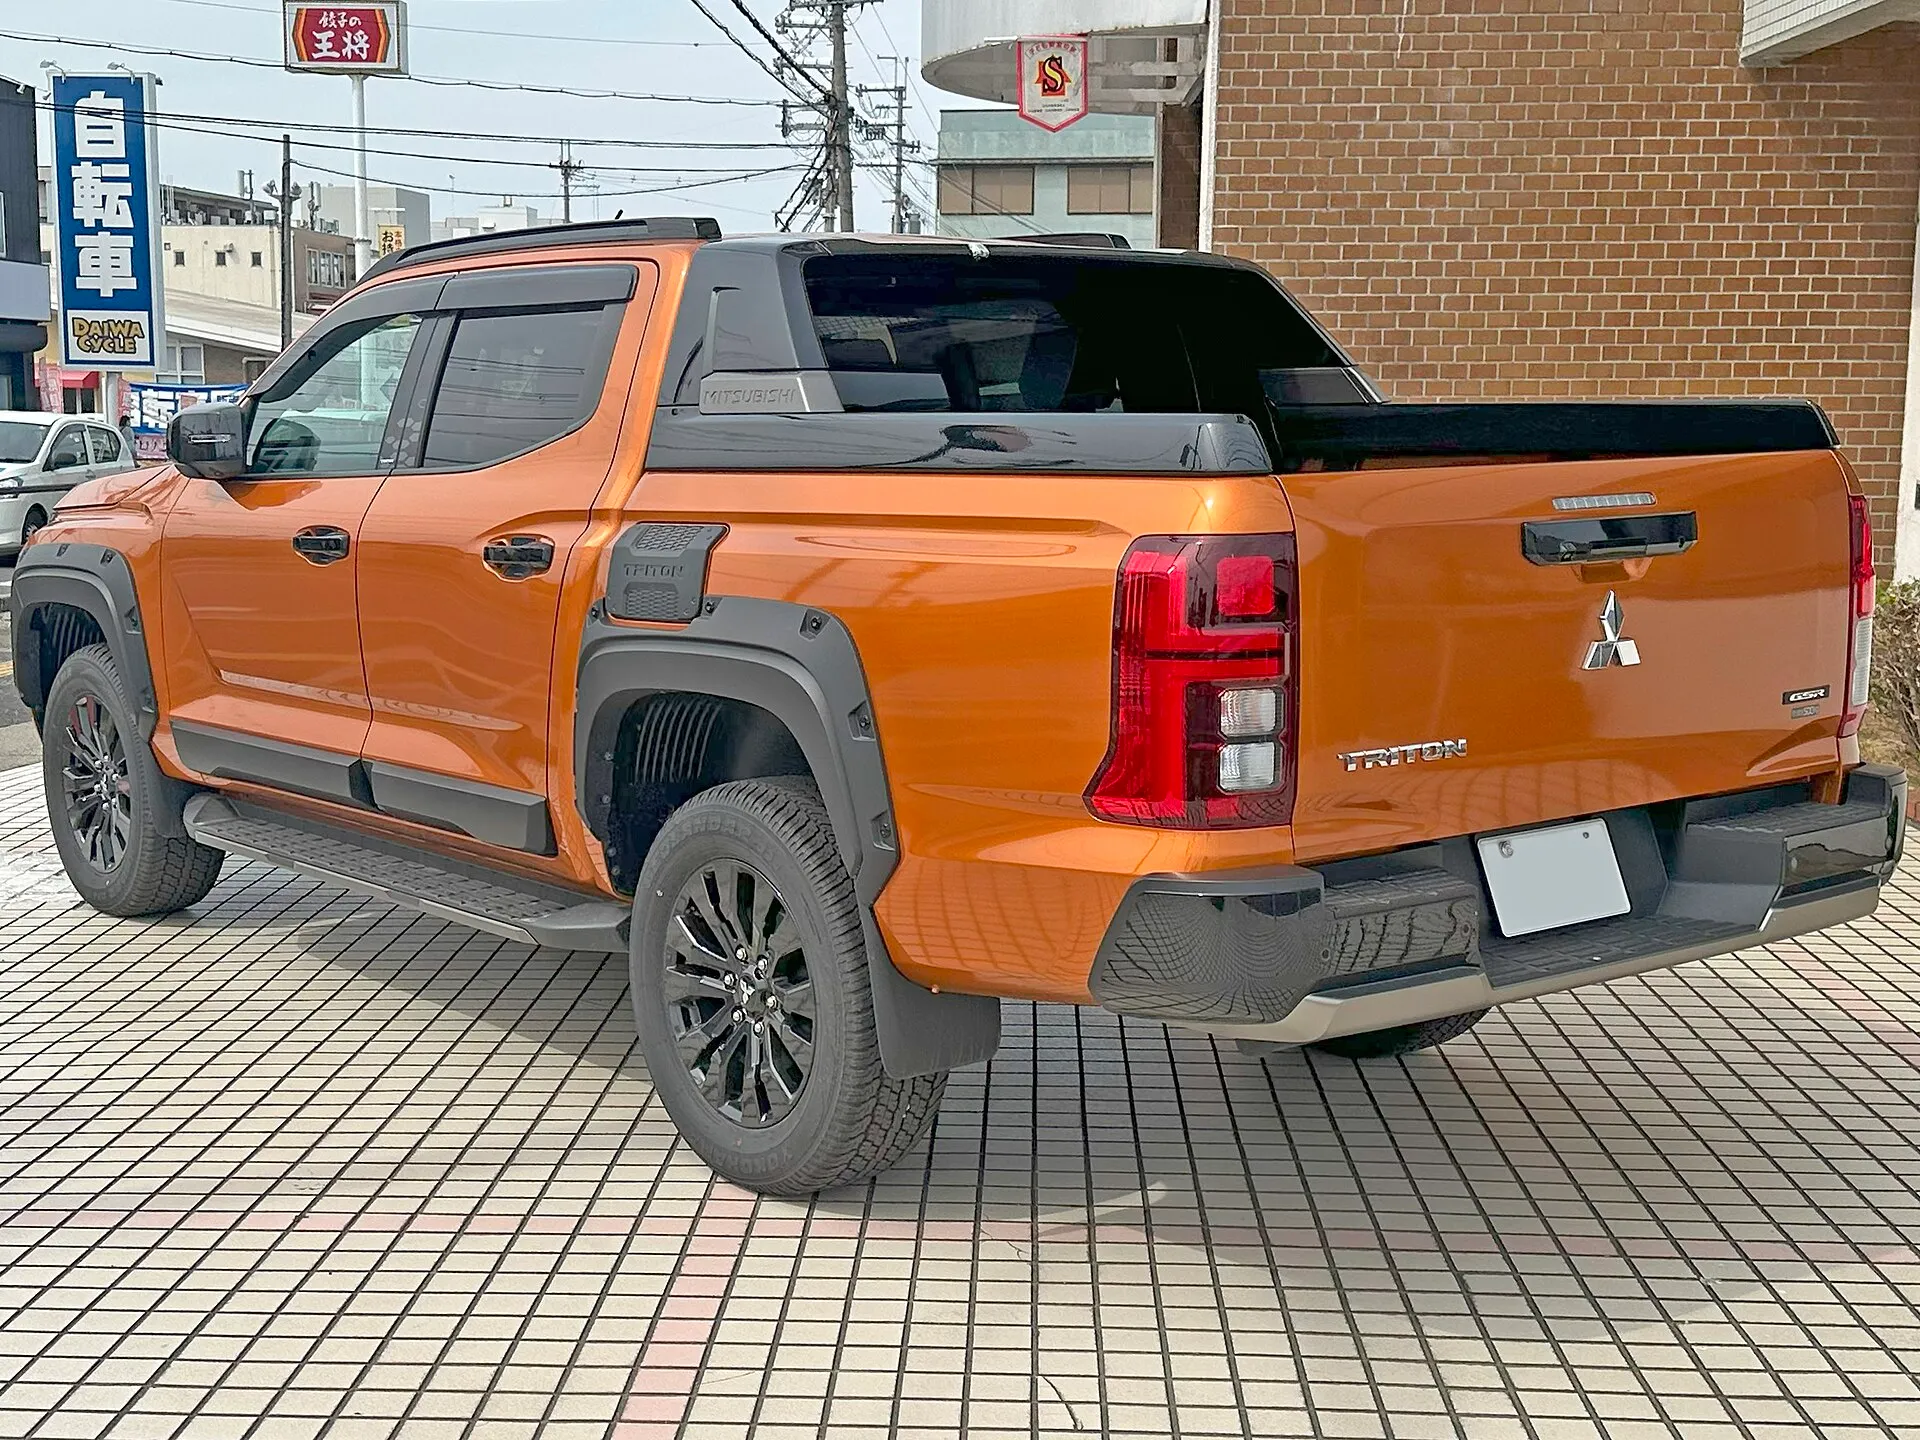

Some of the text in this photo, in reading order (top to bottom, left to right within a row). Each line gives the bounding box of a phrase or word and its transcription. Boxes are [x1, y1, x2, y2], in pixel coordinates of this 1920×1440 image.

[318, 11, 362, 28] 餃子の
[311, 30, 370, 60] 王将
[71, 90, 137, 298] 自転車
[72, 317, 145, 339] DAIWA
[77, 335, 136, 354] CYCLE
[703, 388, 796, 405] MITSUBISHI
[624, 563, 685, 578] TRITON
[1789, 689, 1825, 702] GSR
[1336, 738, 1467, 772] TRITON
